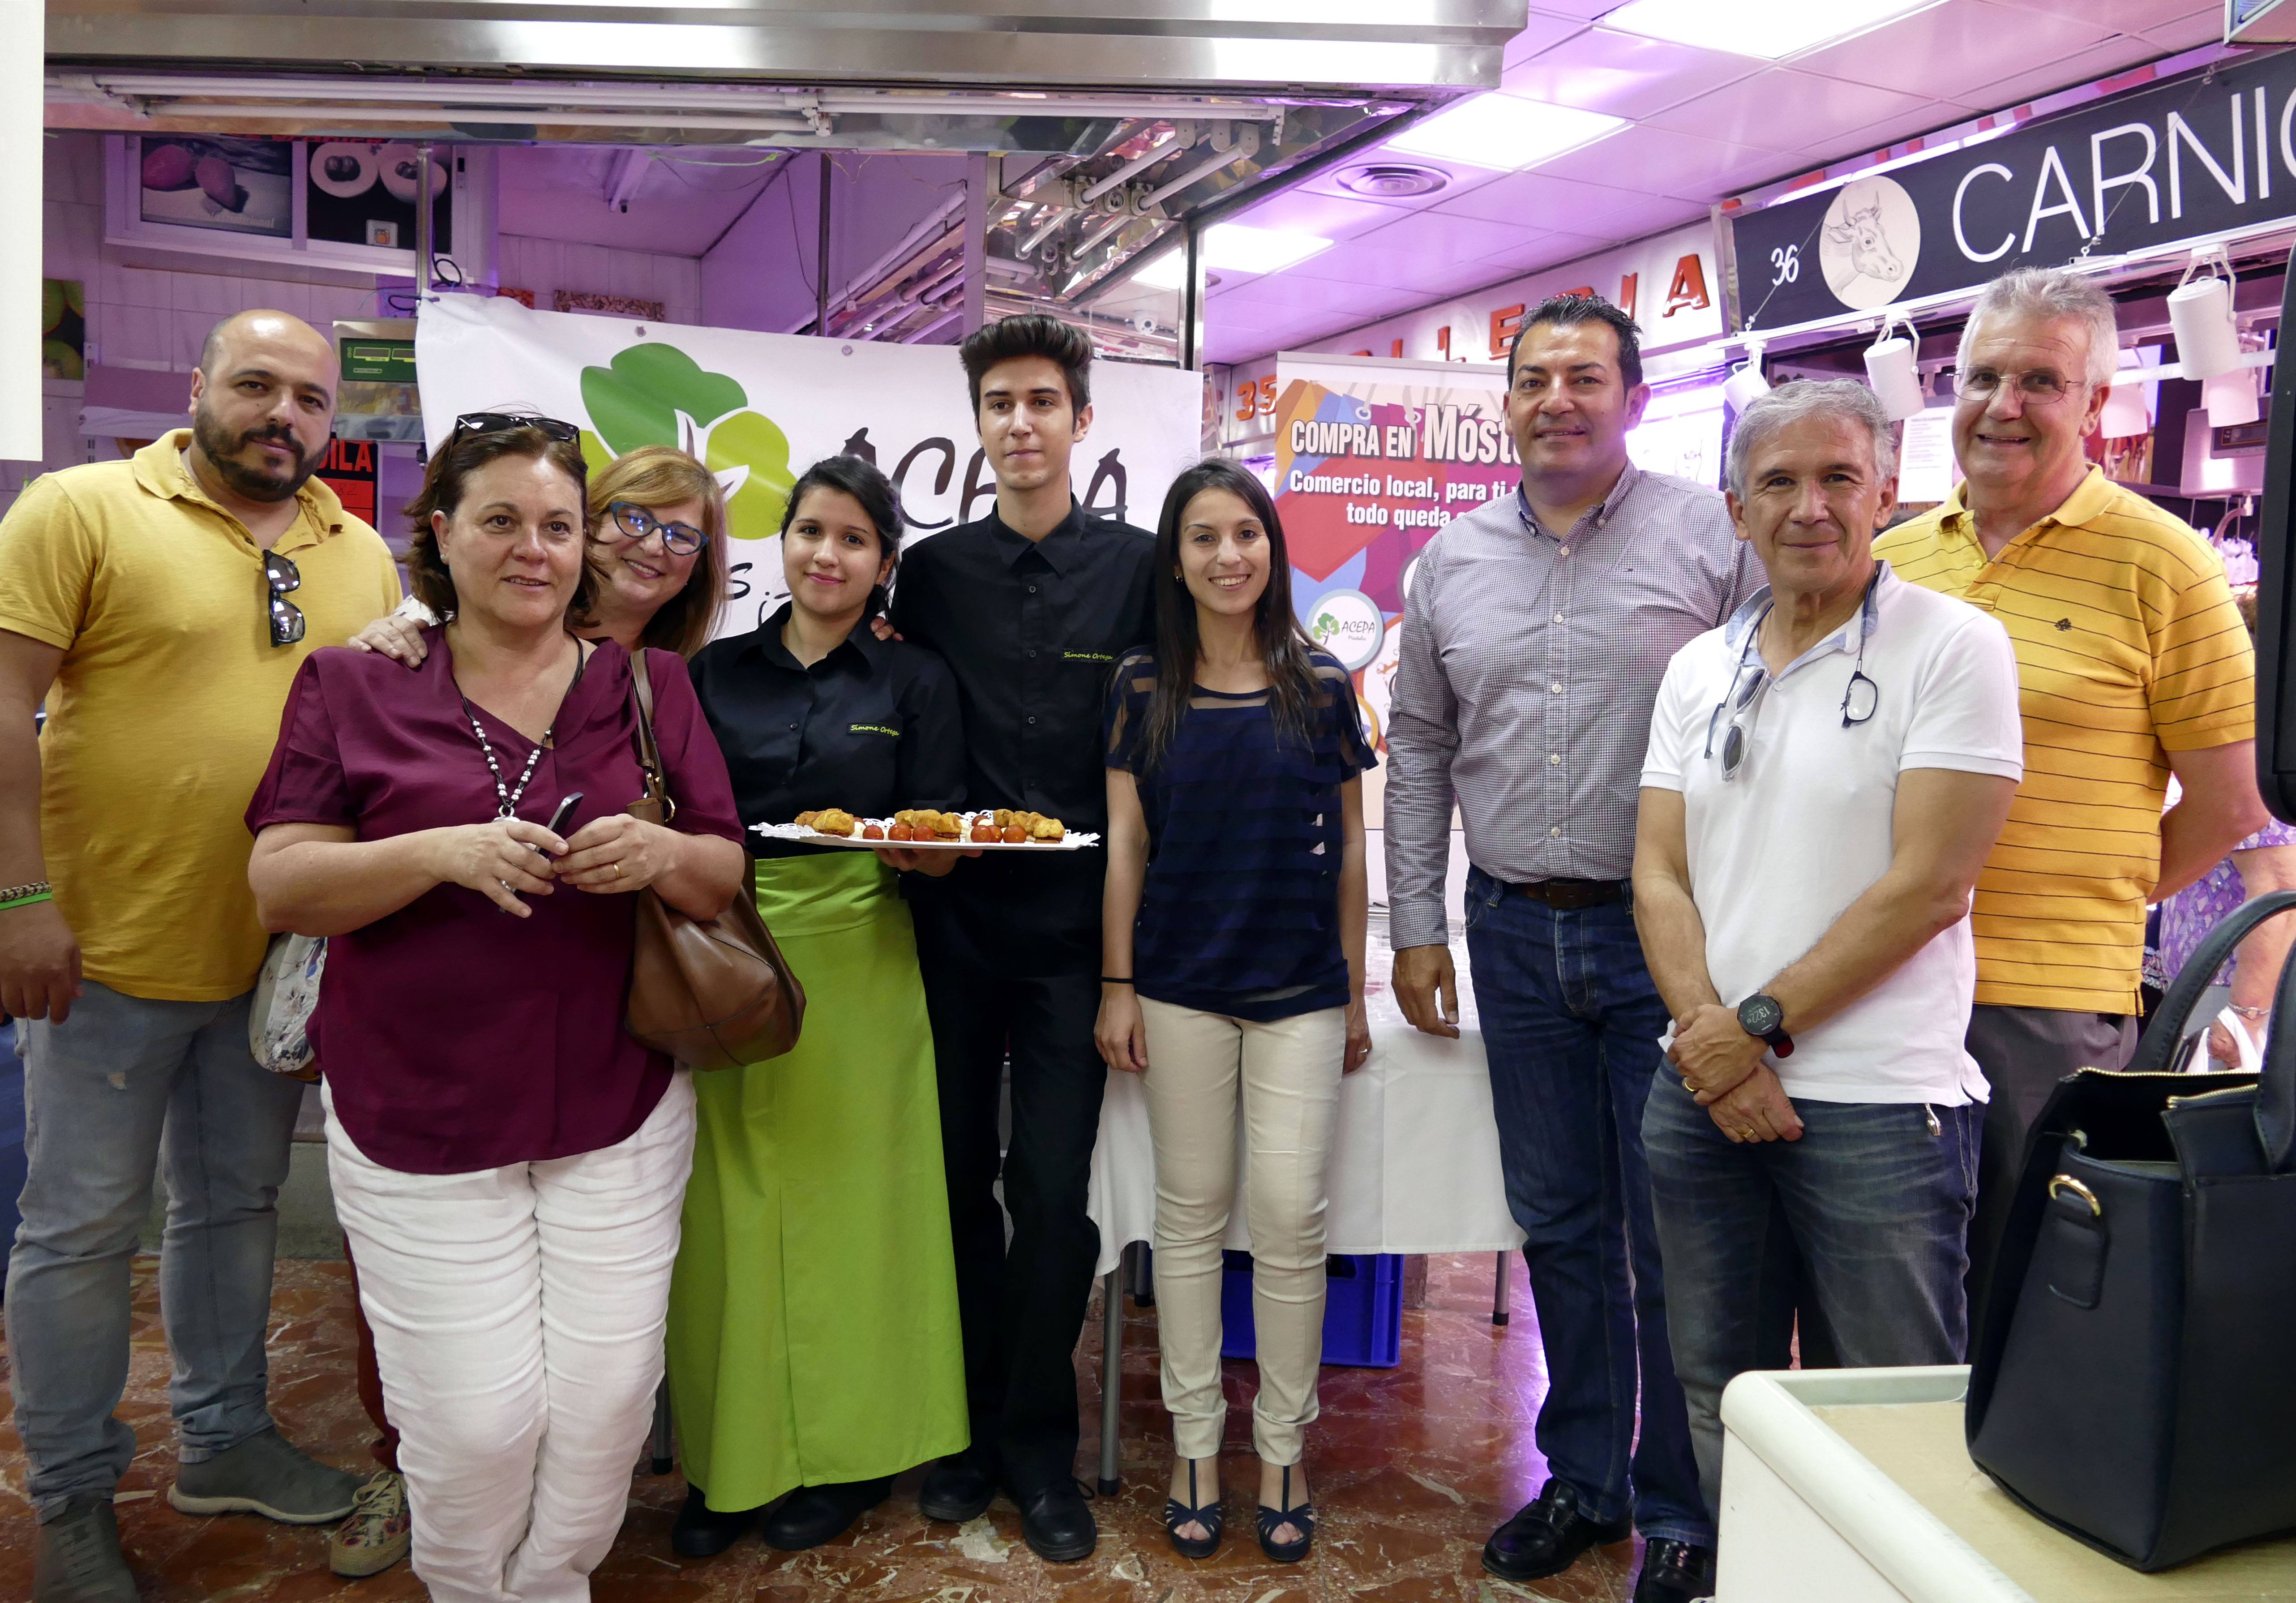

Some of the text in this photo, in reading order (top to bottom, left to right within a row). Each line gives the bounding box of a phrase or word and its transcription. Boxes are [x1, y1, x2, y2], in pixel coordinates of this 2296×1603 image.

[1770, 244, 1799, 286] 36
[1236, 373, 1276, 421] 35
[1290, 403, 1522, 464] COMPRA EN Móst
[1290, 469, 1506, 504] Comercio local, para ti
[1346, 502, 1451, 531] todo queda
[1341, 621, 1375, 634] ACEPA
[1092, 653, 1113, 661] Ortega
[880, 726, 900, 737] Ortega
